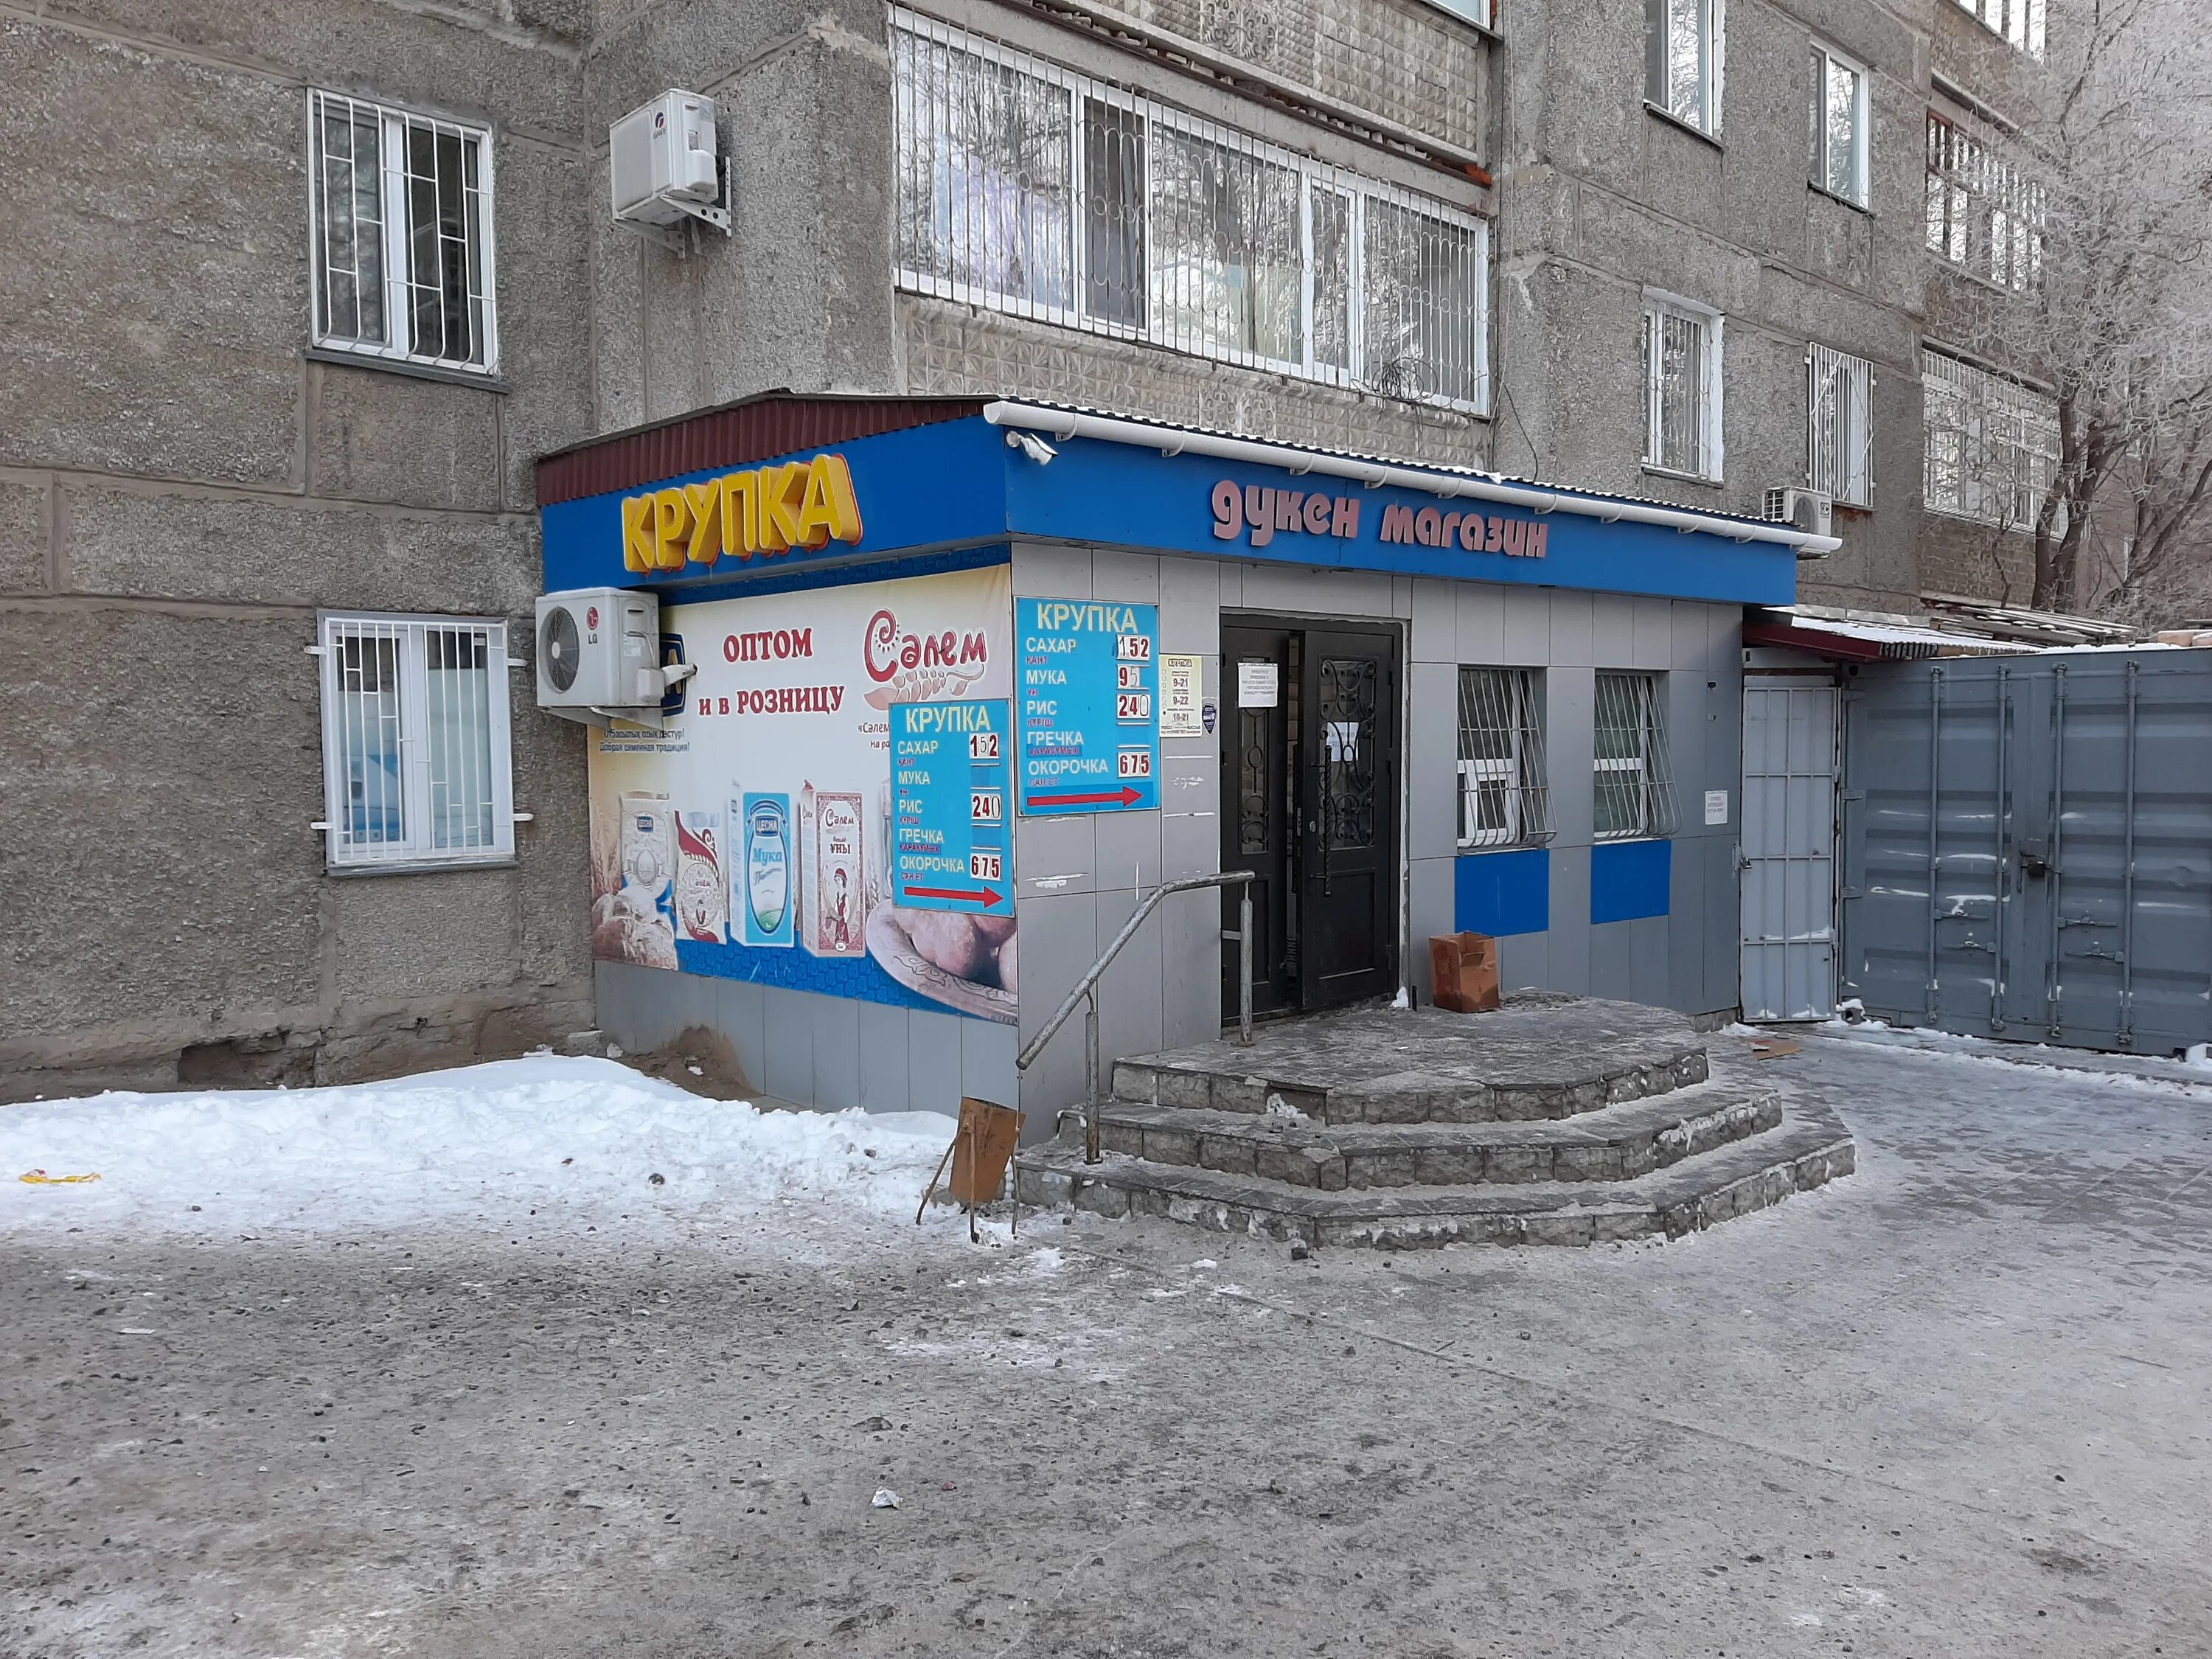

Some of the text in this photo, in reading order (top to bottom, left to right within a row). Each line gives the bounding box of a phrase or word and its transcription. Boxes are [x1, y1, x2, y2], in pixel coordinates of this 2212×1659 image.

[622, 453, 863, 574] КРУПКА
[1380, 503, 1548, 558] магазин
[1037, 602, 1138, 633] КРУПКА
[588, 633, 598, 644] LG
[723, 628, 813, 663] ОПТОМ
[863, 609, 988, 683] Сәлем
[1026, 636, 1149, 658] САХАР 152
[1026, 667, 1138, 687] МУКА 95
[737, 686, 845, 715] РОЗНИЦУ
[1026, 695, 1149, 717] РИС 240
[905, 705, 991, 733] КРУПКА
[897, 734, 998, 757] САХАР 152
[1027, 731, 1085, 746] ГРЕЧКА
[1029, 754, 1150, 776] ОКОРОЧКА 675
[898, 771, 931, 785] МУКА
[899, 796, 1001, 818] РИС 240
[899, 829, 945, 844] ГРЕЧКА
[753, 848, 782, 866] Мука
[900, 855, 1000, 878] ОКОРОЧКА 675
